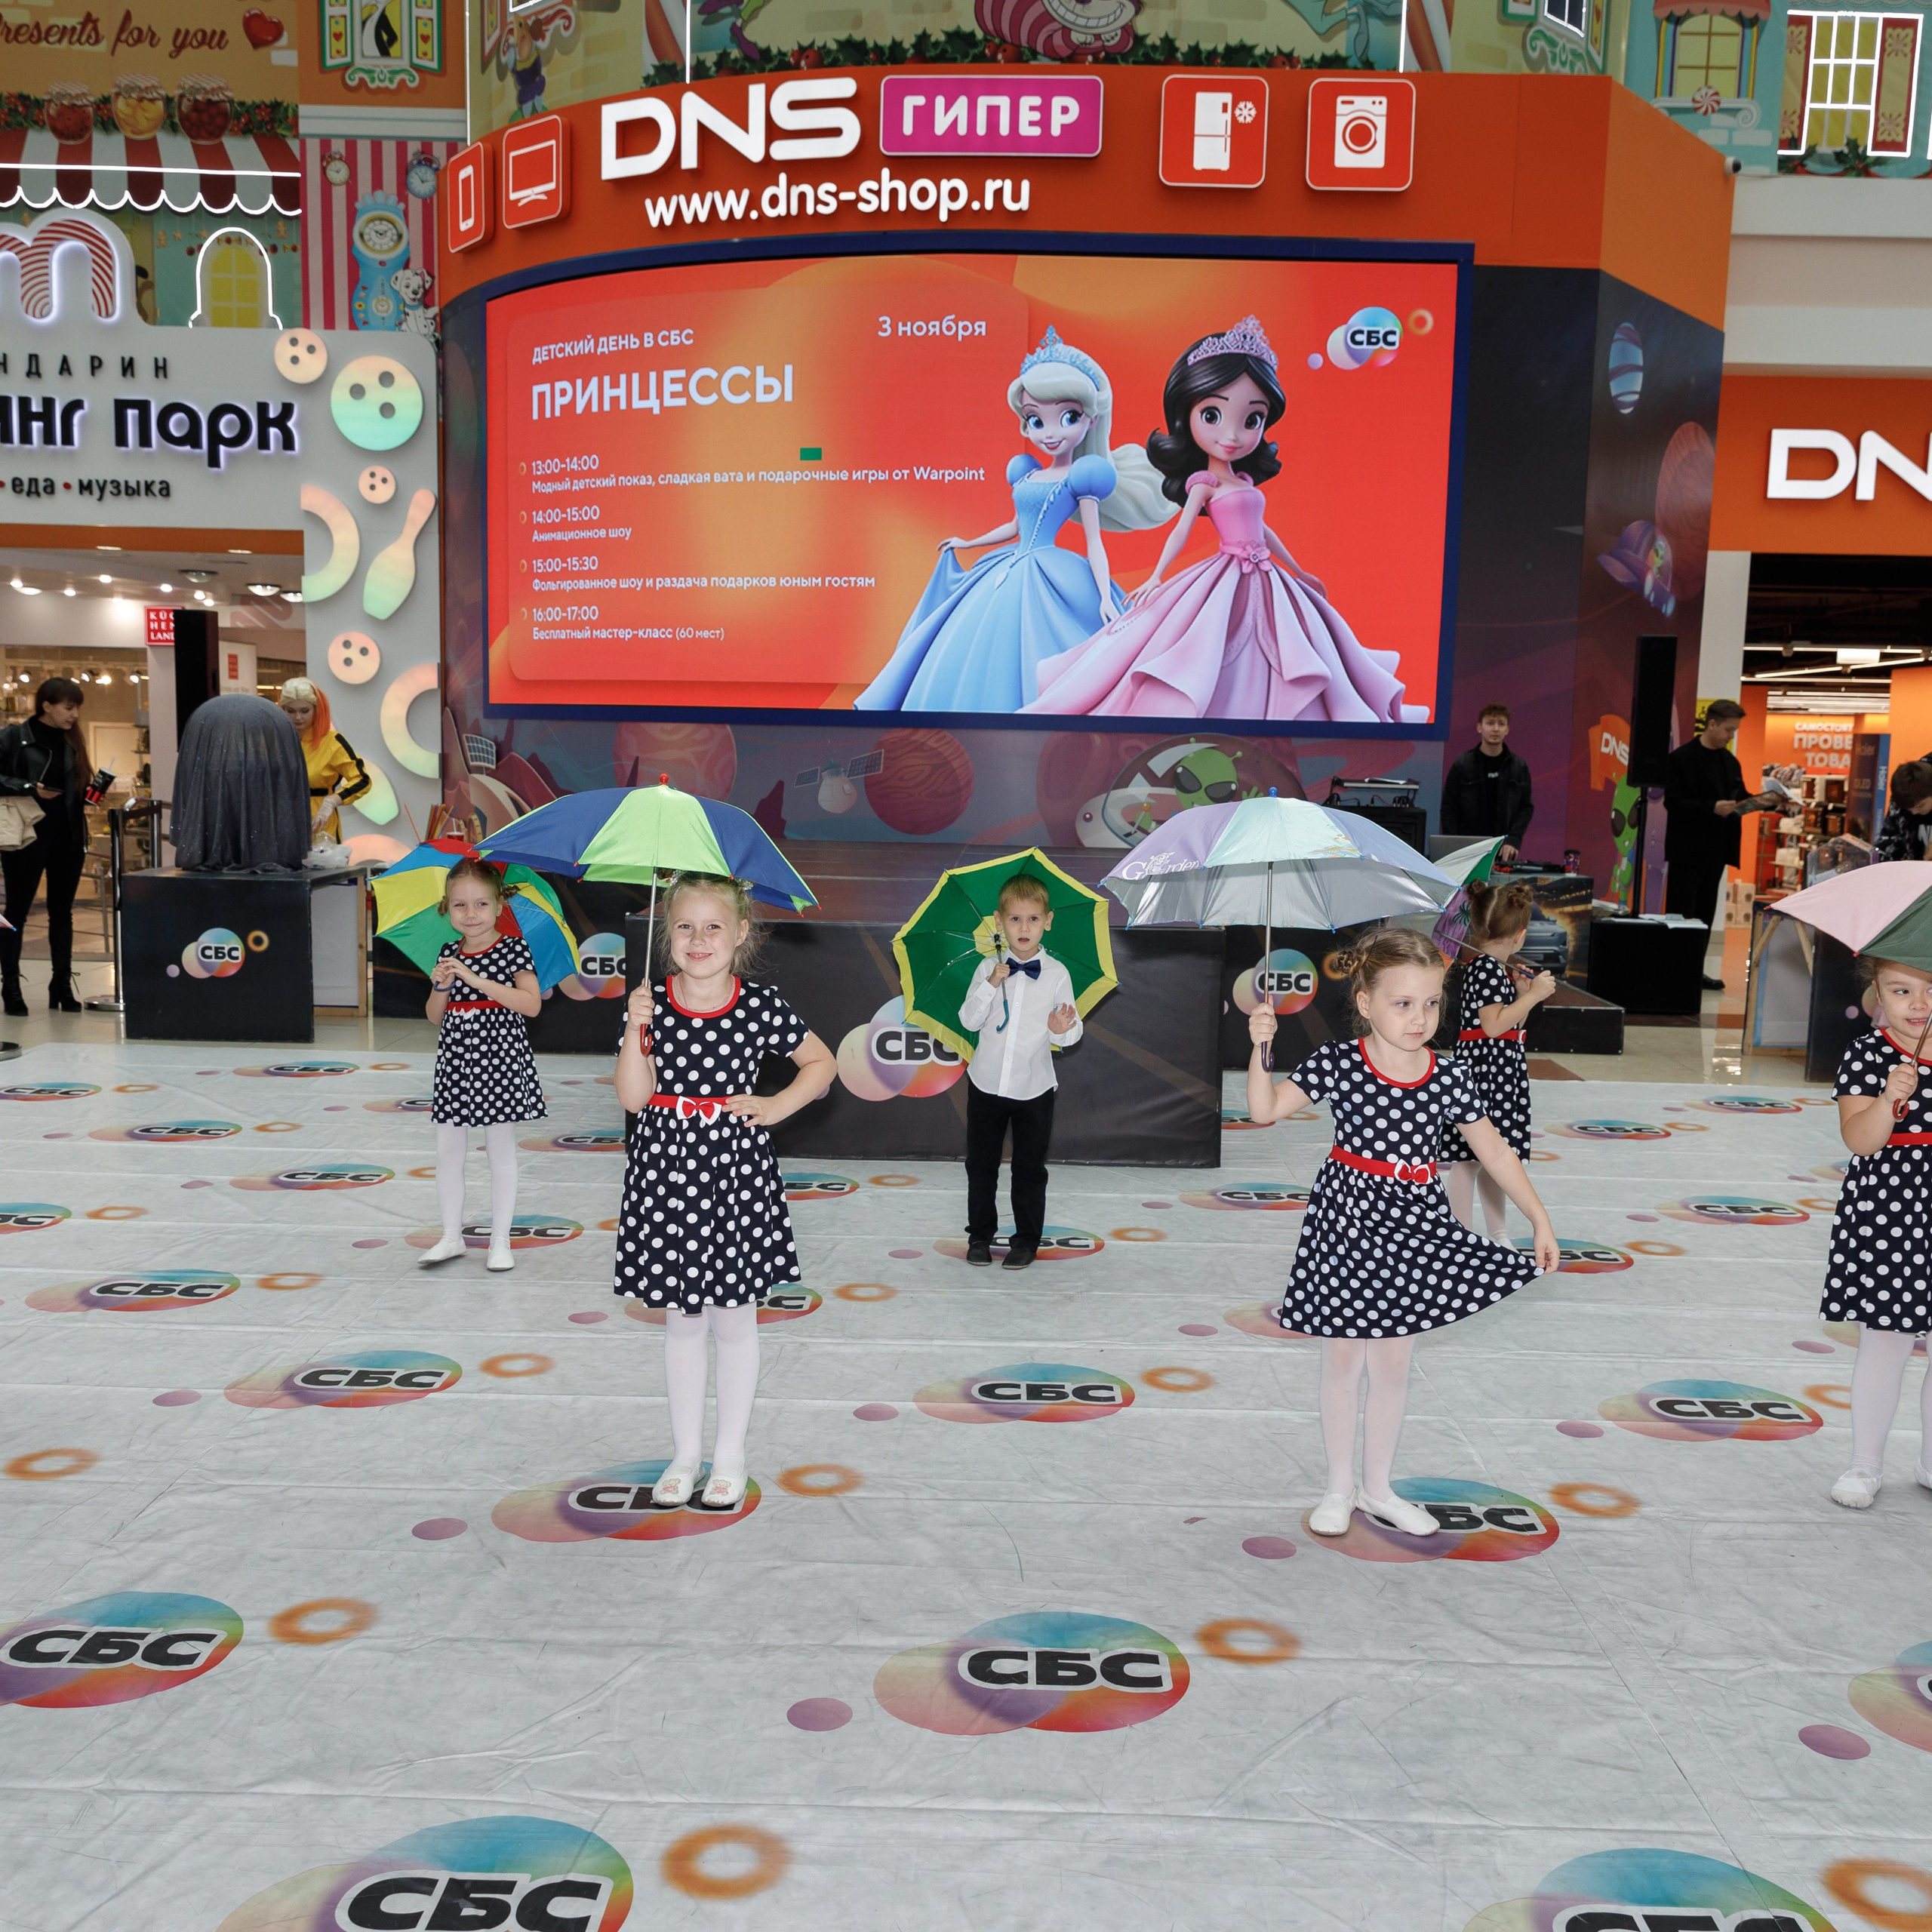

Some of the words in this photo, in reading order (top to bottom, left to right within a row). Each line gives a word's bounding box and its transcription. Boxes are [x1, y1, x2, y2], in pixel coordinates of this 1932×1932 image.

[0, 11, 103, 46] resents
[111, 9, 161, 57] for
[168, 28, 229, 60] you
[902, 94, 1081, 138] ГИПЕР
[601, 77, 862, 181] DNS
[645, 168, 1030, 228] www.dns-shop.ru
[878, 315, 892, 337] 3
[898, 314, 986, 342] ноября
[1349, 329, 1397, 346] СБС
[532, 334, 595, 365] ДЕТСКИЙ
[596, 333, 641, 355] ДЕНЬ
[643, 332, 654, 348] В
[657, 328, 694, 346] СБС
[532, 365, 794, 420] ПРИНЦЕССЫ
[531, 454, 599, 475] 13:00-14:00
[11, 476, 55, 497] еда
[78, 478, 171, 501] музыка
[532, 478, 571, 494] Модный
[572, 474, 616, 491] детский
[618, 474, 655, 487] показ,
[657, 472, 711, 485] сладкая
[713, 471, 743, 483] вата
[746, 471, 756, 481] и
[758, 469, 849, 485] подарочные
[852, 468, 889, 483] игры
[892, 469, 910, 480] от
[913, 466, 985, 483] Warpoint
[532, 505, 600, 525] 14:00-15:00
[532, 529, 606, 542] Анимационное
[608, 527, 632, 540] шоу
[532, 555, 598, 573] 15:00-15:30
[532, 577, 617, 592] Фольгированное
[619, 577, 643, 590] шоу
[646, 578, 654, 588] и
[656, 577, 708, 590] раздача
[711, 577, 777, 589] подарков
[780, 577, 822, 587] юным
[825, 577, 875, 587] гостям
[532, 605, 598, 622] 16:00-17:00
[533, 626, 591, 640] Бесплатный
[593, 627, 673, 641] мастер-класс
[675, 626, 694, 641] (60
[696, 627, 724, 641] мест)
[1793, 734, 1852, 750] ПРОВЕ
[200, 945, 240, 963] СБС
[1257, 971, 1312, 993] СБС
[272, 1065, 350, 1073] СБС
[5, 1088, 89, 1096] СБС
[138, 1127, 229, 1136] СБС
[1577, 1126, 1660, 1134] СБС
[284, 1172, 382, 1182] СБС
[1694, 1204, 1798, 1215] СБС
[96, 1282, 223, 1297] СБС
[300, 1369, 445, 1388] СБС
[978, 1383, 1116, 1402] СБС
[1656, 1399, 1804, 1420] СБС
[8, 1629, 218, 1666] СБС
[968, 1650, 1164, 1688] СБС
[347, 1877, 602, 1932] СБС
